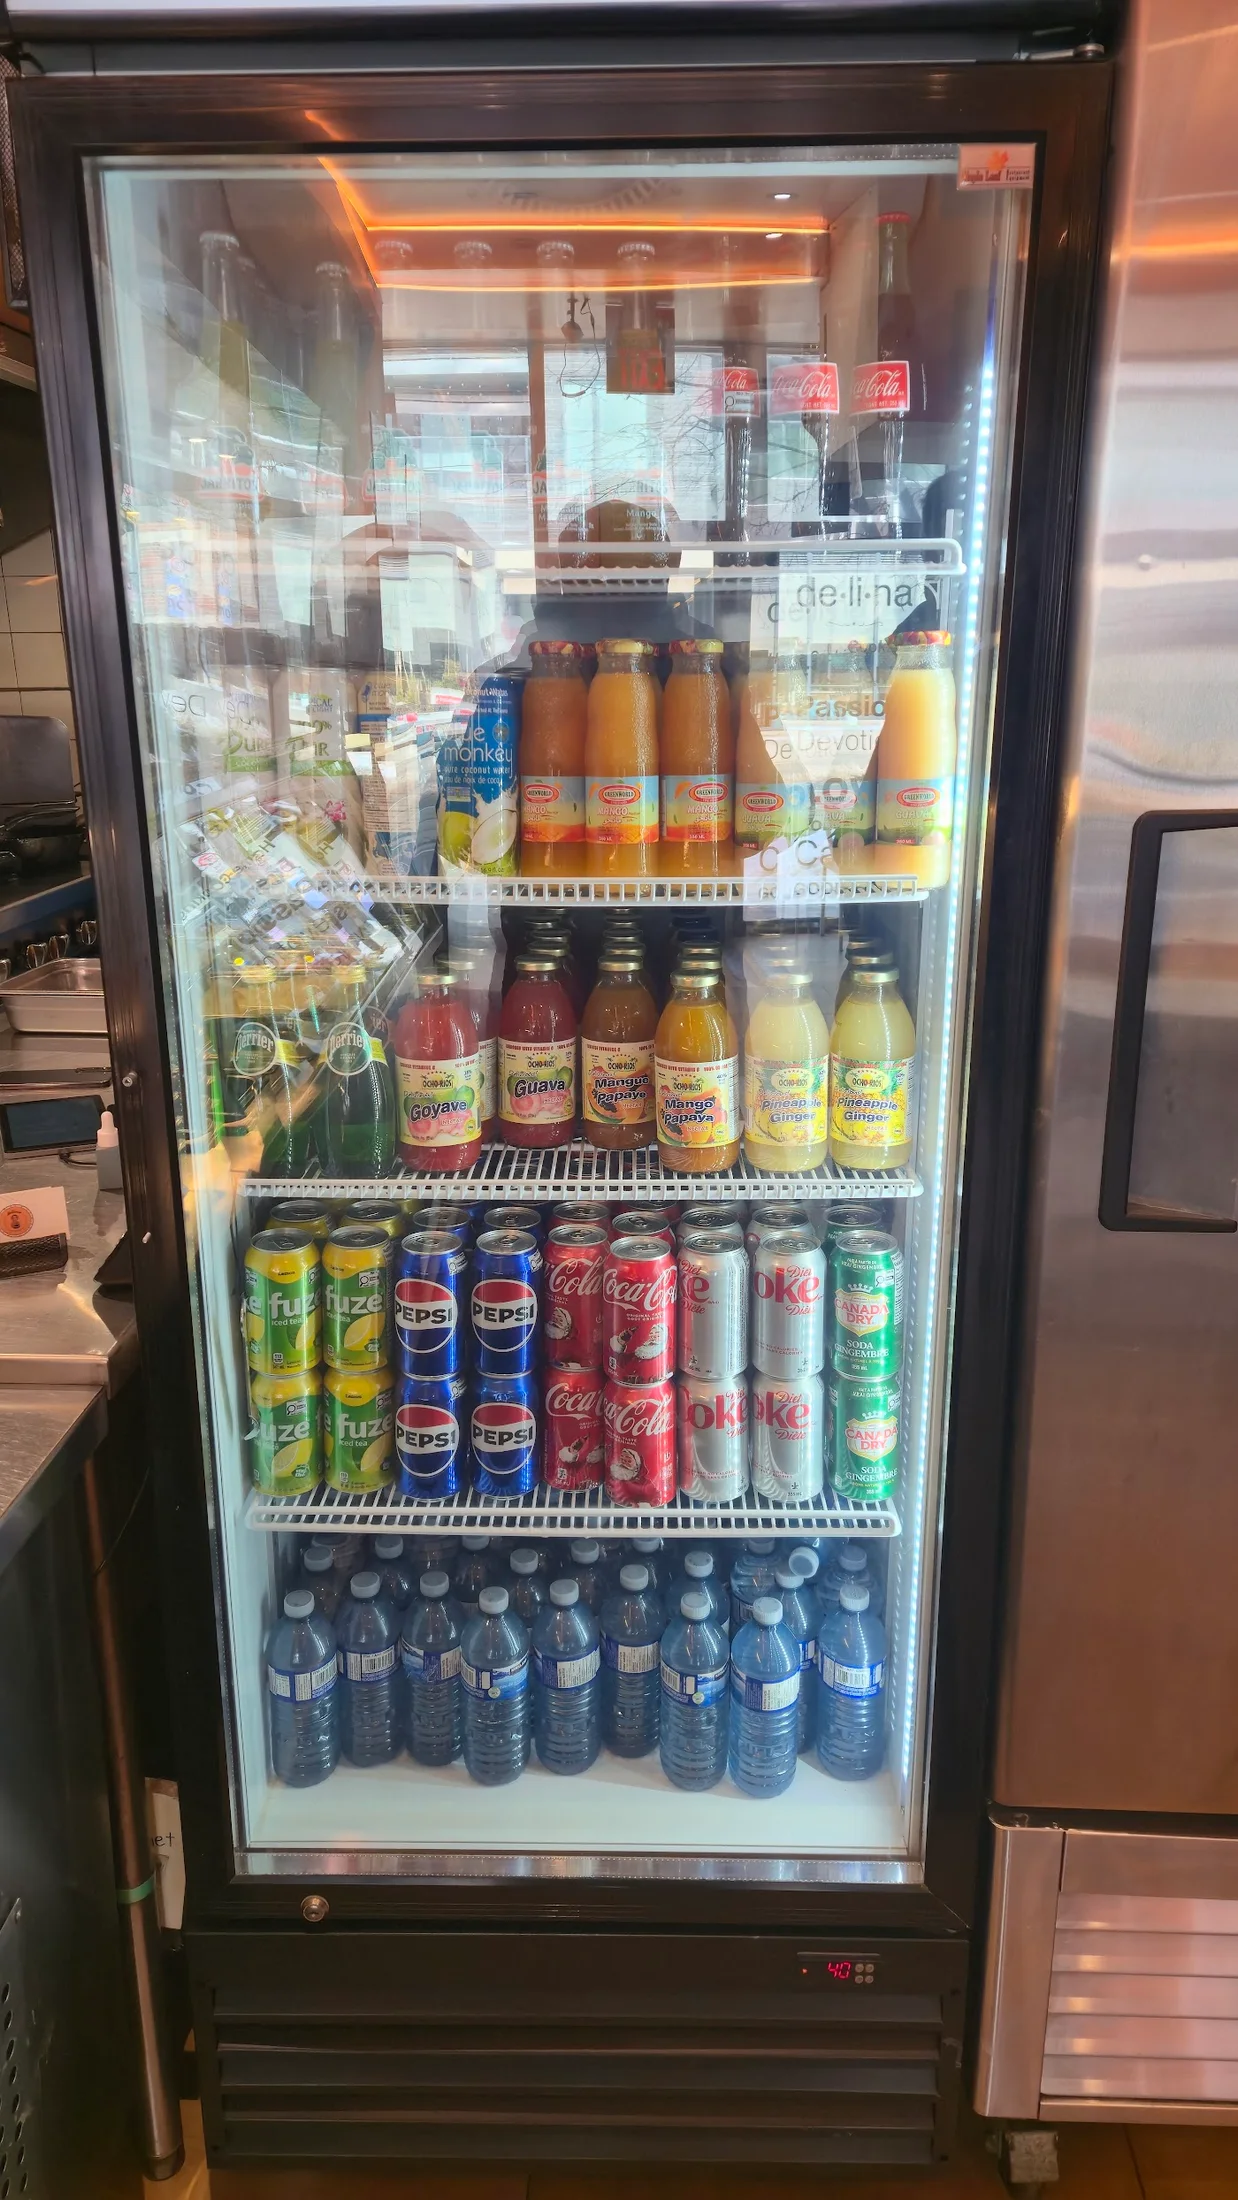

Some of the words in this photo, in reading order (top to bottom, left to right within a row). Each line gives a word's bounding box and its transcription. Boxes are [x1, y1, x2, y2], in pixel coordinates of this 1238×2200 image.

[444, 743, 513, 779] monkey
[461, 766, 490, 774] coconut
[493, 766, 511, 774] water
[477, 776, 485, 784] de
[604, 789, 634, 798] GREENWORLD
[697, 788, 724, 797] GREENWORLD
[597, 805, 628, 815] MANGO
[688, 804, 719, 814] MANGO
[896, 810, 929, 819] GUAVA
[528, 1060, 555, 1068] OCHO-RIOS
[607, 1062, 635, 1070] OCHO-RIOS
[422, 1080, 452, 1088] OCHO-RIOS
[595, 1077, 649, 1089] Mangue
[673, 1082, 701, 1091] OCHO-RIOS
[778, 1079, 808, 1087] OCHO-RIOS
[852, 1077, 881, 1087] OCHO-RIOS
[514, 1079, 565, 1098] Guava
[597, 1091, 646, 1105] Papaye
[837, 1097, 898, 1110] Pineapple
[665, 1099, 713, 1110] Mango
[761, 1098, 822, 1111] Pineapple
[410, 1101, 467, 1122] Goyave
[844, 1112, 889, 1122] Ginger
[664, 1113, 714, 1125] Papaya
[770, 1112, 816, 1124] Ginger
[681, 1260, 701, 1276] Diet
[787, 1265, 812, 1278] Diet
[753, 1267, 820, 1304] oke
[325, 1285, 383, 1314] fuze
[395, 1302, 452, 1324] PEPSI
[473, 1301, 534, 1323] PEPSI
[834, 1299, 888, 1315] CANADA
[272, 1317, 288, 1325] iced
[289, 1317, 302, 1325] tea
[846, 1314, 873, 1324] DRY
[835, 1343, 889, 1358] GINGEMBRE
[846, 1340, 874, 1350] SODA
[775, 1391, 803, 1404] Diet
[752, 1392, 810, 1430] oke
[260, 1420, 310, 1442] uze
[396, 1425, 455, 1448] PEPSI
[473, 1423, 532, 1445] PEPSI
[846, 1427, 898, 1441] CANADA
[860, 1441, 886, 1450] DRY
[845, 1468, 897, 1482] GINGEMBRE
[861, 1466, 886, 1474] SODA
[828, 1961, 851, 1979] 40
